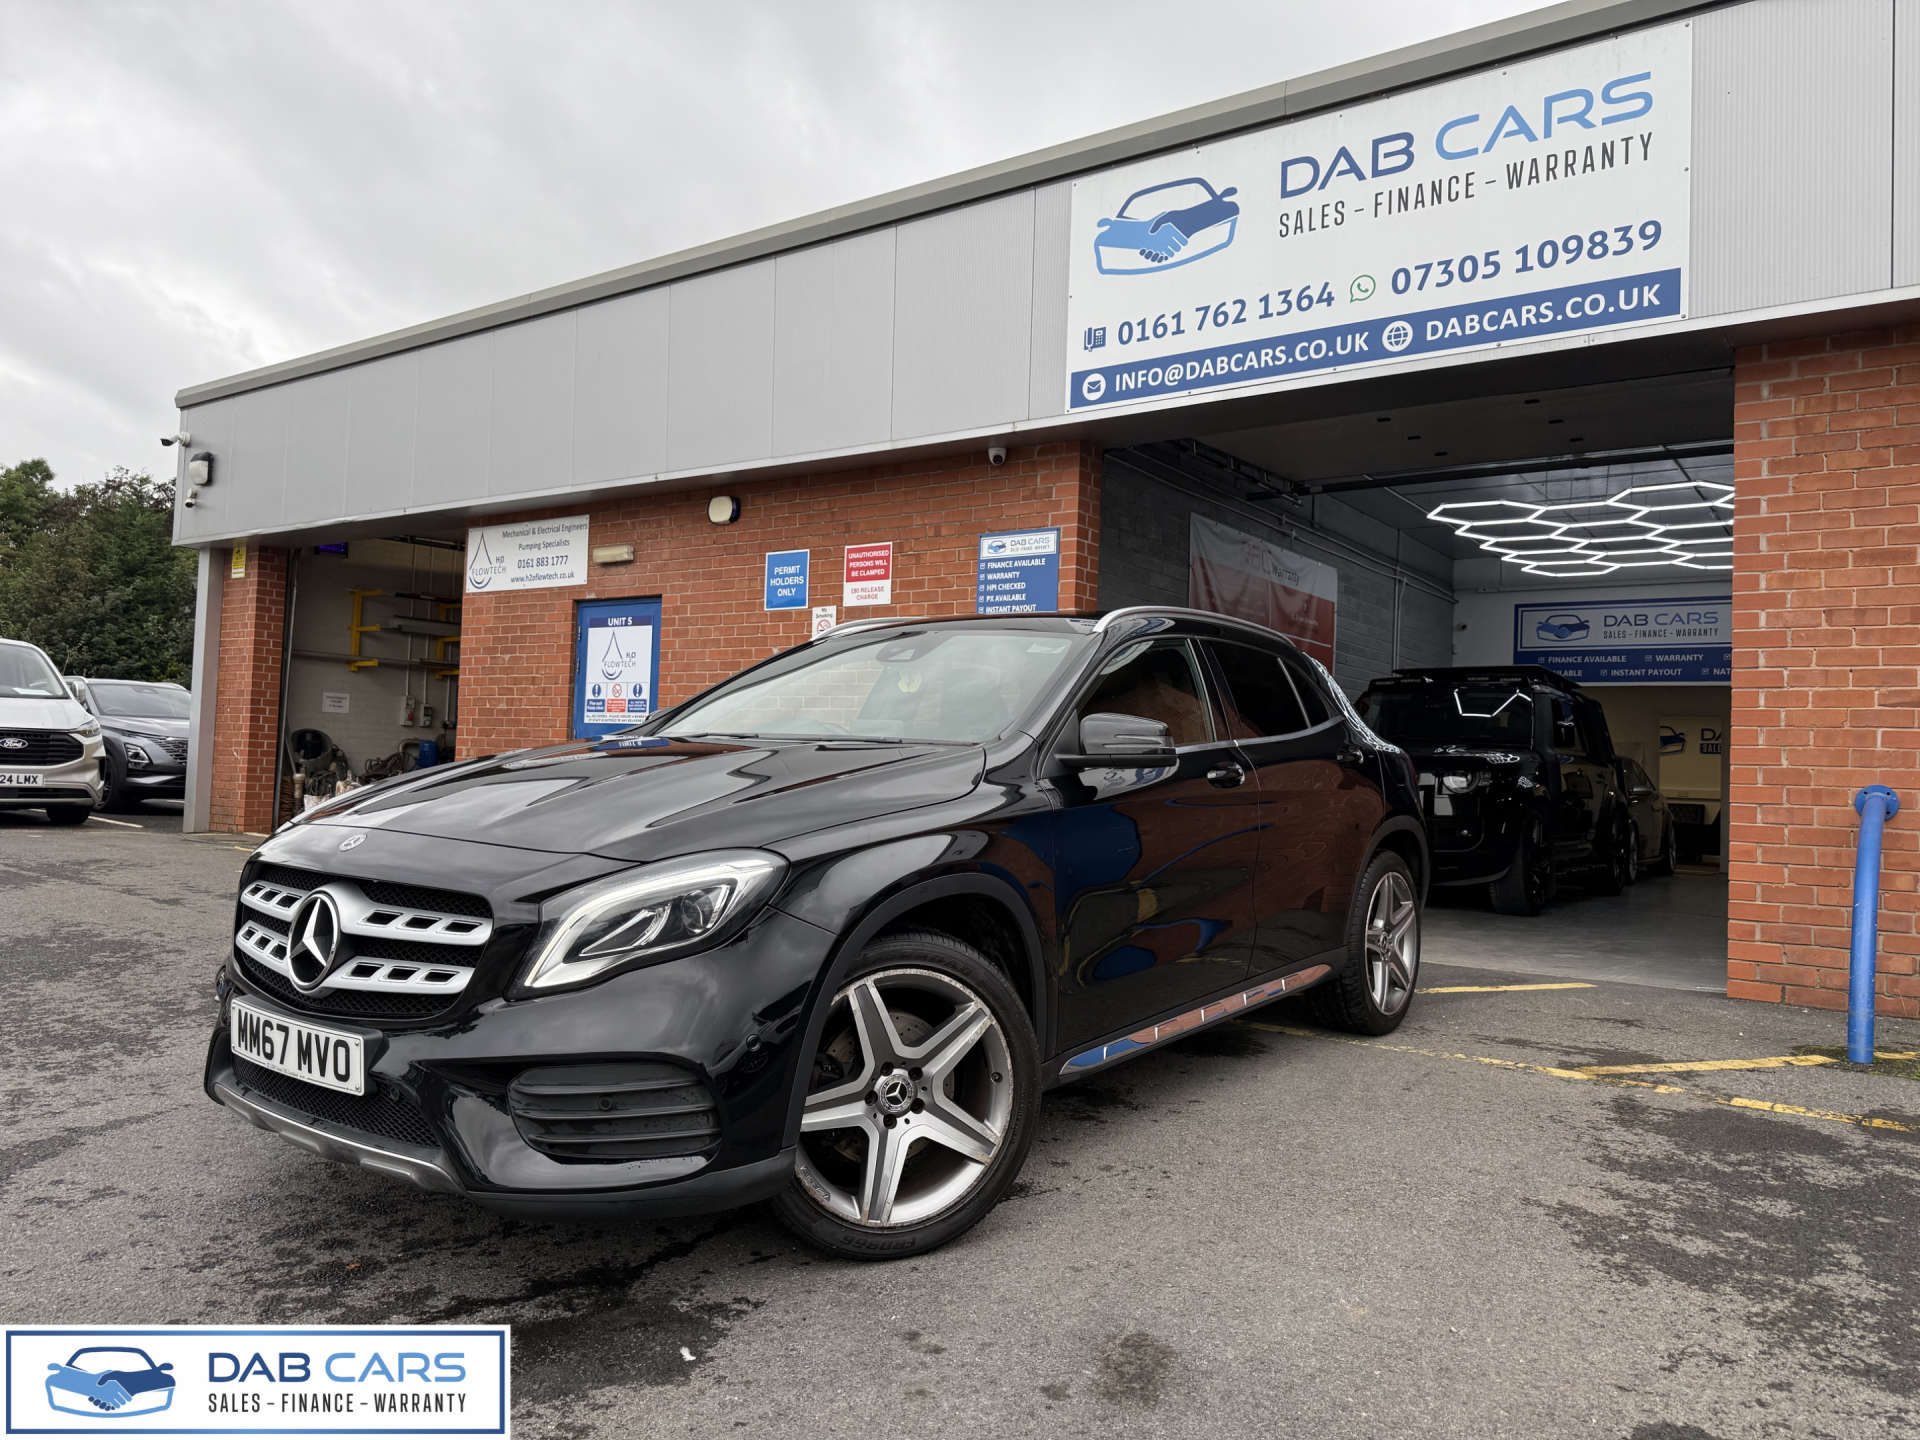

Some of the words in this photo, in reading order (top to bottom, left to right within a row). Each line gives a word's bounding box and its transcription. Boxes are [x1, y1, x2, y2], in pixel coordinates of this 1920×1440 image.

[1279, 131, 1415, 199] DAB
[1435, 71, 1654, 161] CARS
[1279, 200, 1346, 238] SALES
[1374, 171, 1475, 218] FINANCE
[1505, 131, 1653, 190] WARRANTY
[1391, 250, 1501, 295] 07305
[1514, 220, 1662, 274] 109839
[1117, 311, 1185, 345] 0161
[1195, 298, 1247, 331] 762
[1258, 281, 1335, 319] 1364
[1425, 283, 1661, 342] DABCARS.CO.UK
[1115, 331, 1369, 392] INFO@DABCARS.CO.UK
[502, 528, 530, 538] Mechanical
[531, 527, 536, 535] &
[537, 525, 560, 535] Electrical
[561, 523, 588, 533] Engineers
[518, 542, 541, 551] Pumping
[542, 538, 570, 549] Specialists
[1010, 538, 1027, 547] DAB
[1027, 536, 1050, 545] CARS
[848, 550, 889, 559] UNAUTHORISED
[517, 559, 534, 569] 0161
[536, 556, 549, 567] 883
[551, 555, 568, 566] 1777
[849, 560, 874, 568] PERSONS
[987, 560, 1014, 569] FINANCE
[1014, 558, 1046, 567] AVAILABLE
[471, 566, 507, 576] FLOWTECH
[774, 565, 800, 575] PERMIT
[859, 568, 885, 576] CLAMPED
[770, 576, 804, 586] HOLDERS
[986, 571, 1020, 581] WARRANTY
[997, 582, 1026, 590] CHECKED
[777, 587, 796, 597] ONLY
[995, 593, 1026, 602] AVAILABLE
[985, 605, 1011, 615] INSTANT
[1011, 604, 1037, 613] PAYOUT
[607, 616, 626, 626] UNIT
[627, 616, 633, 625] 5
[1603, 614, 1649, 627] DAB
[1654, 611, 1719, 626] CARS
[1603, 630, 1627, 639] SALES
[1634, 628, 1668, 639] FINANCE
[1675, 627, 1719, 637] WARRANTY
[1548, 656, 1582, 664] FINANCE
[1583, 655, 1627, 663] AVAILABLE
[1655, 654, 1704, 662] WARRANTY
[604, 660, 636, 669] FLOWTECH
[1611, 669, 1646, 677] INSTANT
[1647, 668, 1683, 676] PAYOUT
[16, 775, 38, 784] LMX
[238, 1008, 290, 1065] MM67
[297, 1029, 351, 1083] MVO
